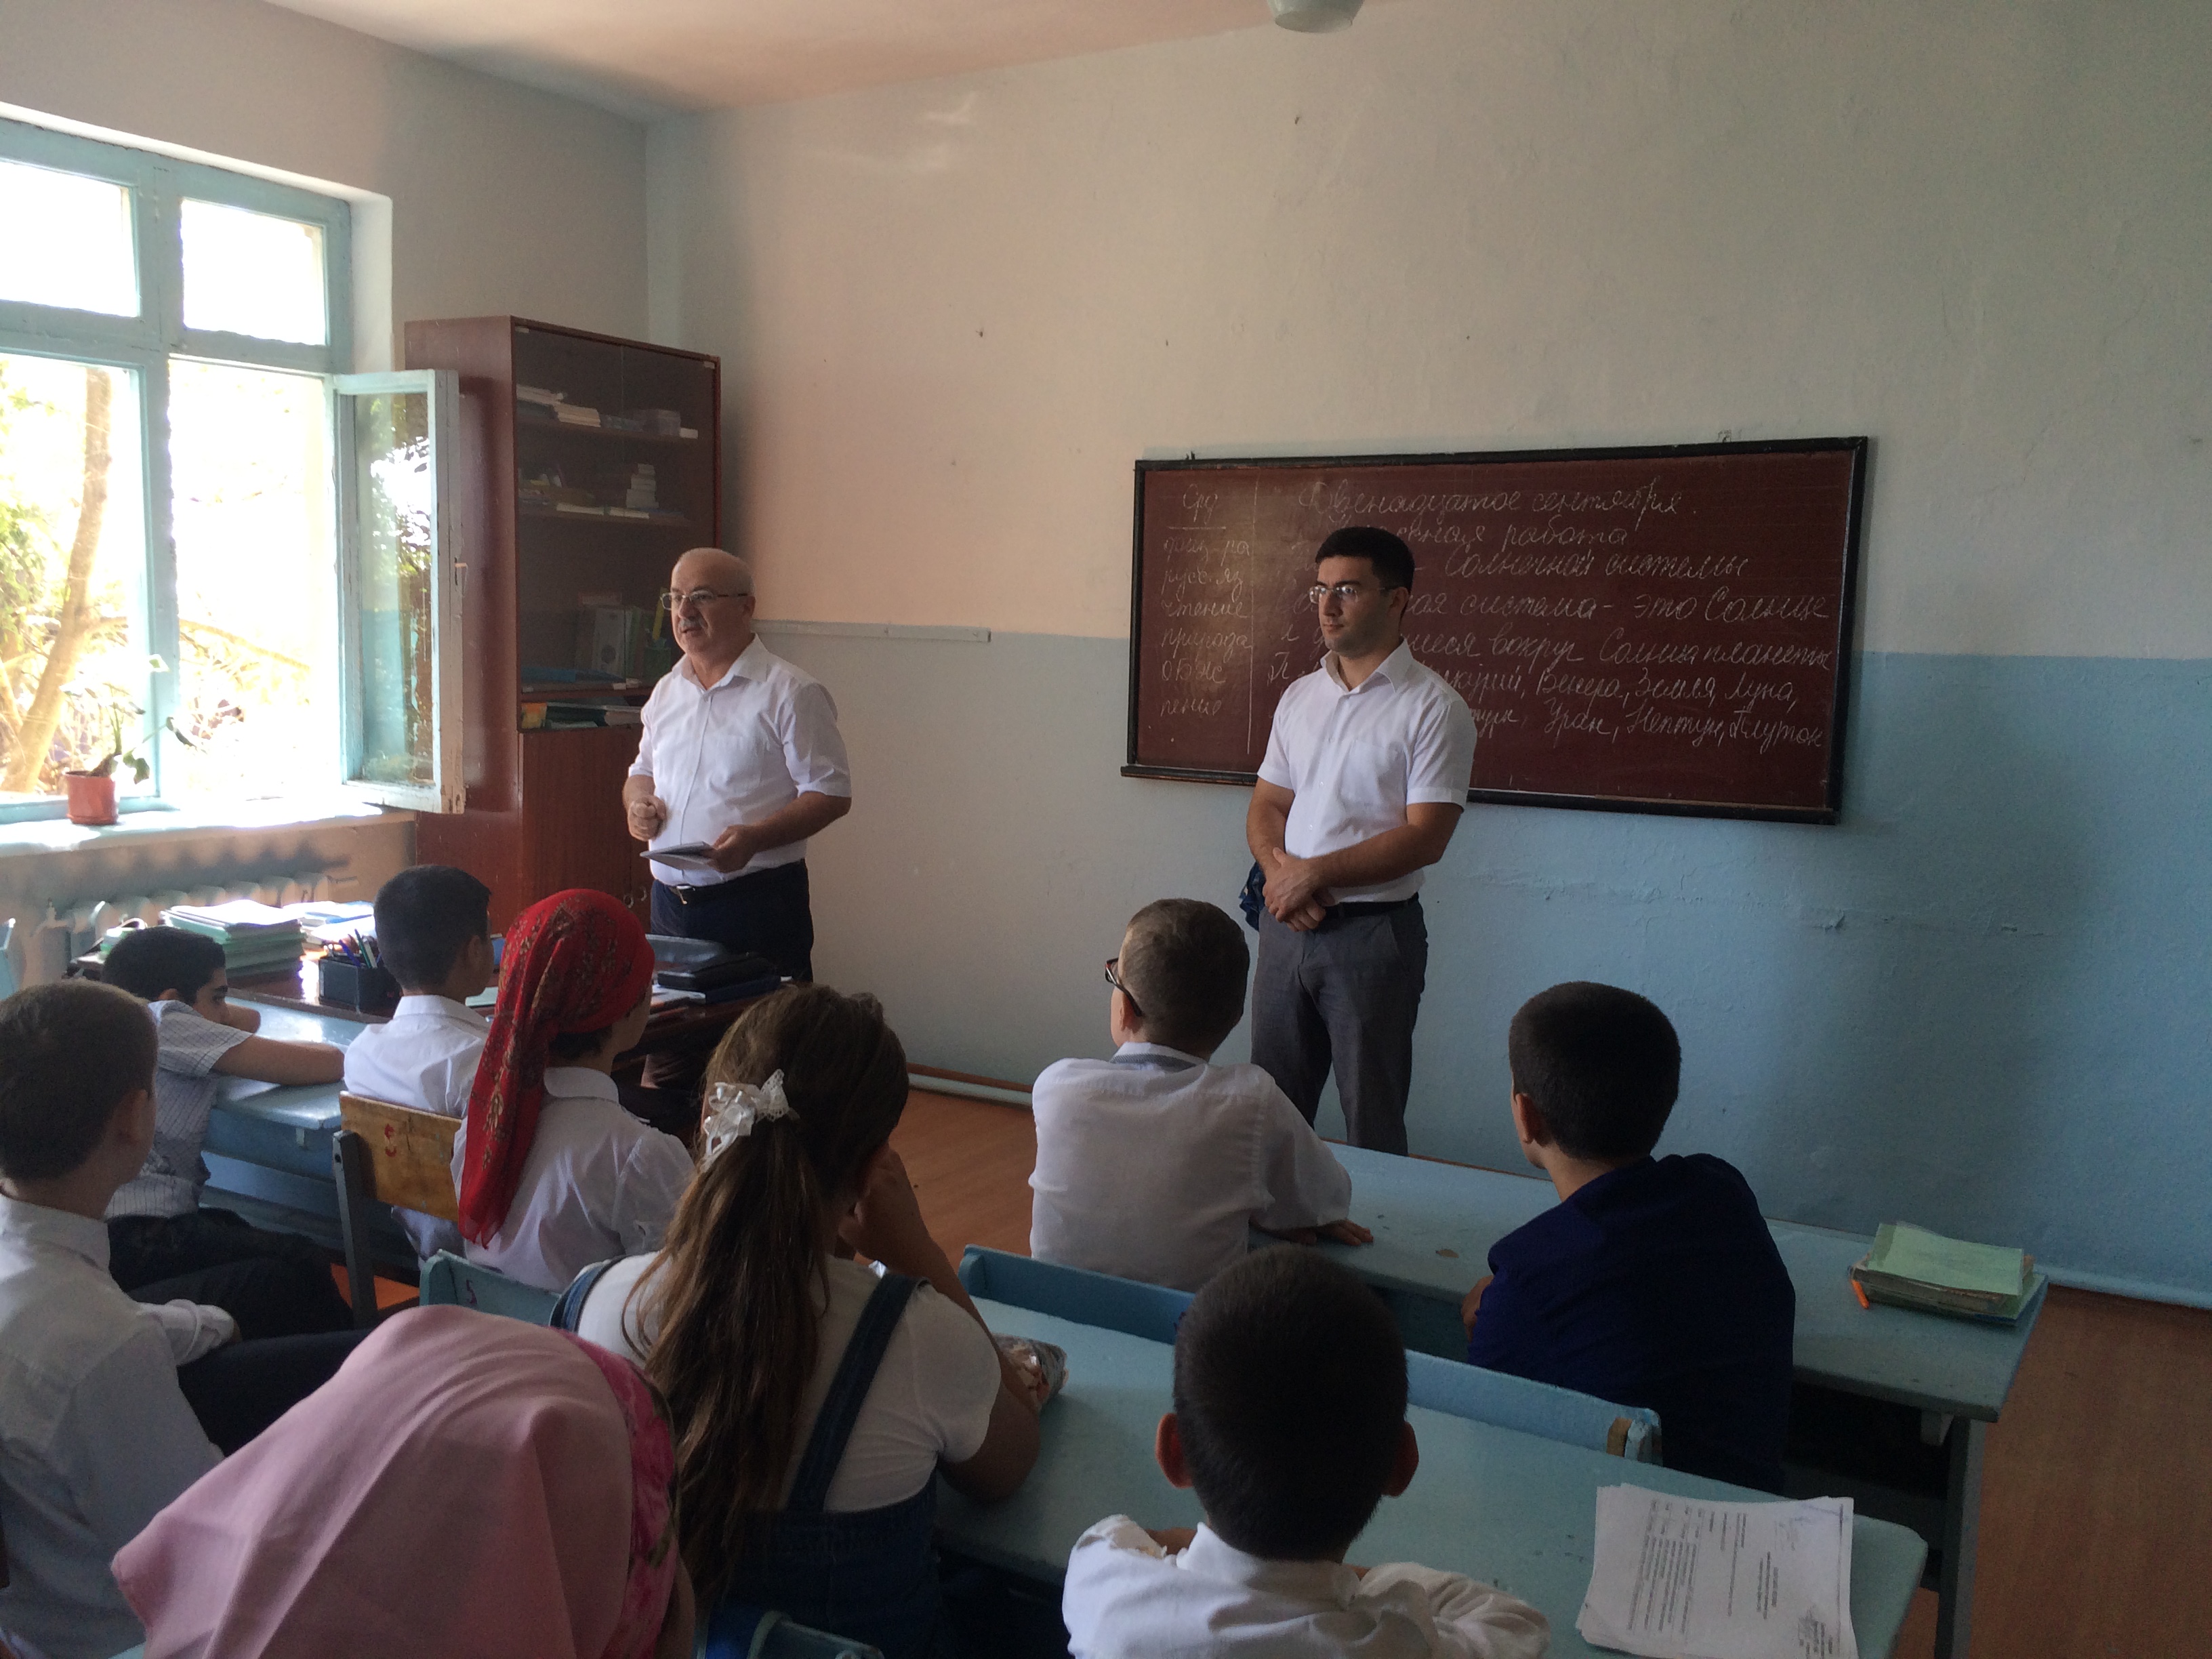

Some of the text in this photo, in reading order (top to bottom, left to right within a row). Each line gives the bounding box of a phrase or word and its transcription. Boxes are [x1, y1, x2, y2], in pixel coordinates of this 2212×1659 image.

[1501, 514, 1627, 552] работа
[1636, 594, 1697, 620] это
[1704, 586, 1829, 623] Солнце
[1161, 627, 1253, 664] природа
[1489, 622, 1584, 674] вокруг
[1703, 641, 1833, 670] планеты
